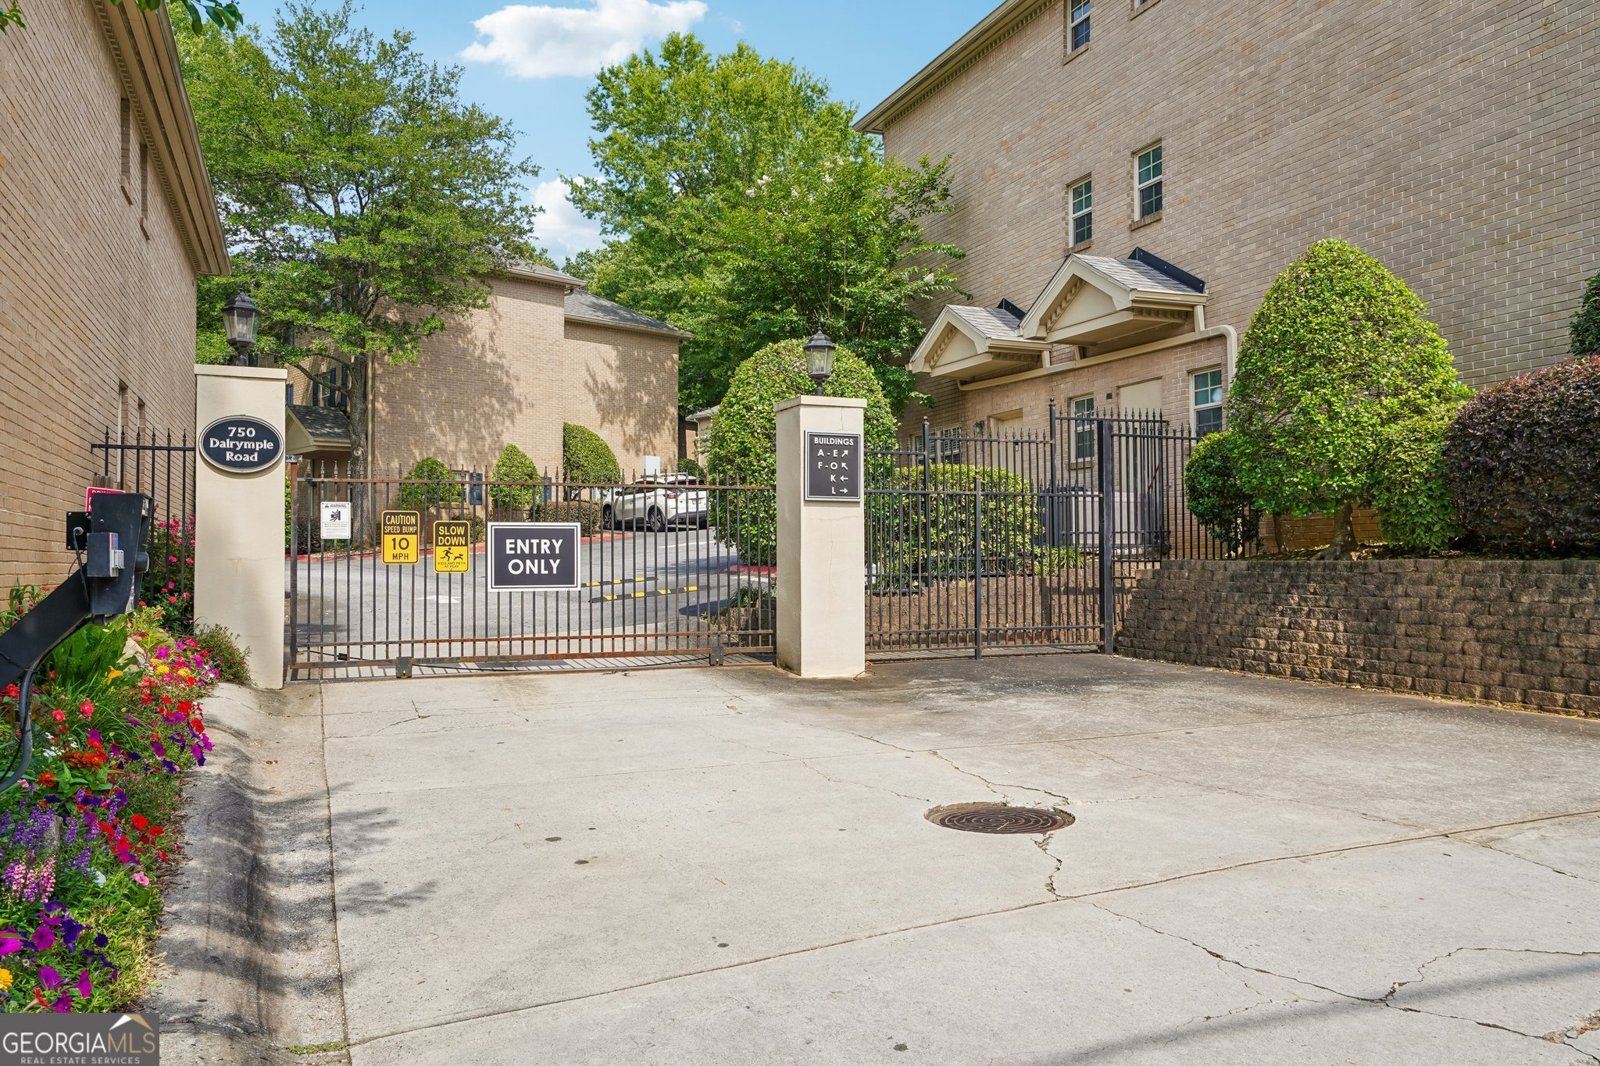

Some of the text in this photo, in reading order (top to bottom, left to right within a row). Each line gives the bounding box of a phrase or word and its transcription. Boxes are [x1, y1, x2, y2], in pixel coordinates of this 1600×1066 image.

[228, 427, 256, 437] 750
[209, 438, 274, 451] Dalrymple
[814, 437, 854, 446] BUILDINGS
[225, 451, 258, 462] Road
[830, 474, 836, 482] K
[831, 486, 836, 494] L
[385, 514, 416, 525] CAUTION
[438, 526, 465, 535] SLOW
[391, 537, 410, 550] 10
[438, 537, 466, 545] DOWN
[505, 539, 563, 554] ENTRY
[508, 559, 560, 574] ONLY
